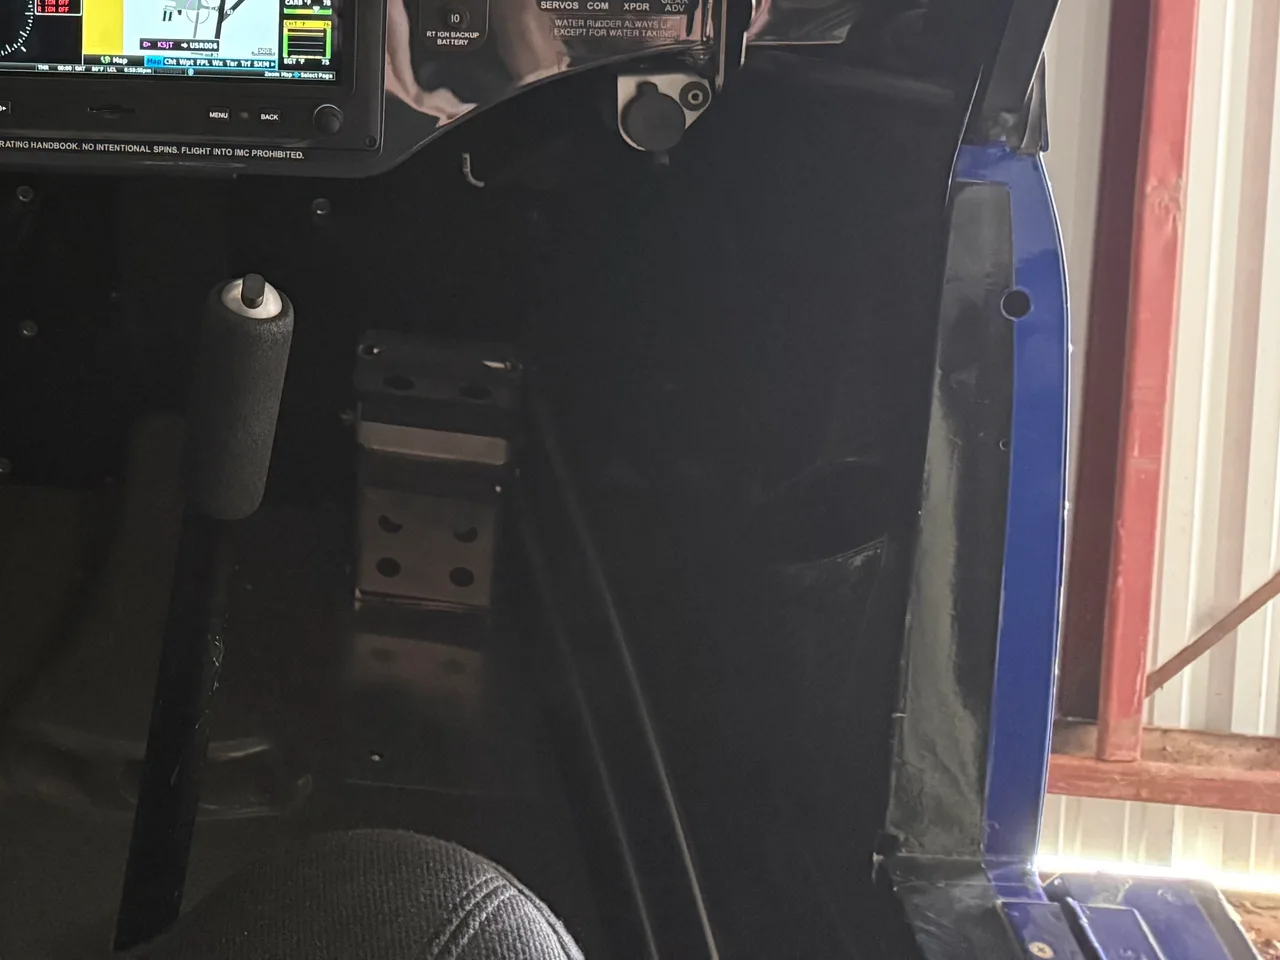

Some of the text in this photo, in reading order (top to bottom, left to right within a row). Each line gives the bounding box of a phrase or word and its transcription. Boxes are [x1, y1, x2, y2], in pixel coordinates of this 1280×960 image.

[540, 0, 579, 10] SERVOS
[586, 1, 609, 10] COM
[623, 2, 650, 11] XPDR
[664, 4, 685, 12] ADV
[451, 13, 460, 23] 10
[554, 19, 659, 29] WATER RUDDER ALWAYS
[426, 30, 480, 39] RT IGN BACKUP
[554, 28, 639, 37] EXCEPT FOR WATER
[157, 41, 174, 49] KSJT
[436, 38, 469, 46] BATTERY
[112, 56, 128, 64] Map
[147, 57, 162, 66] Map
[179, 58, 195, 67] Wpt
[253, 60, 270, 68] SXM
[209, 112, 229, 120] MENU
[261, 113, 278, 121] BACK
[31, 140, 80, 150] HANDBOOK.
[82, 143, 94, 151] NO
[96, 143, 151, 153] INTENTIONAL
[153, 145, 180, 154] SPINS.
[181, 146, 211, 155] FLIGHT
[213, 148, 233, 156] INTO
[234, 148, 250, 157] IMC
[251, 149, 304, 159] PROHIBITED.
